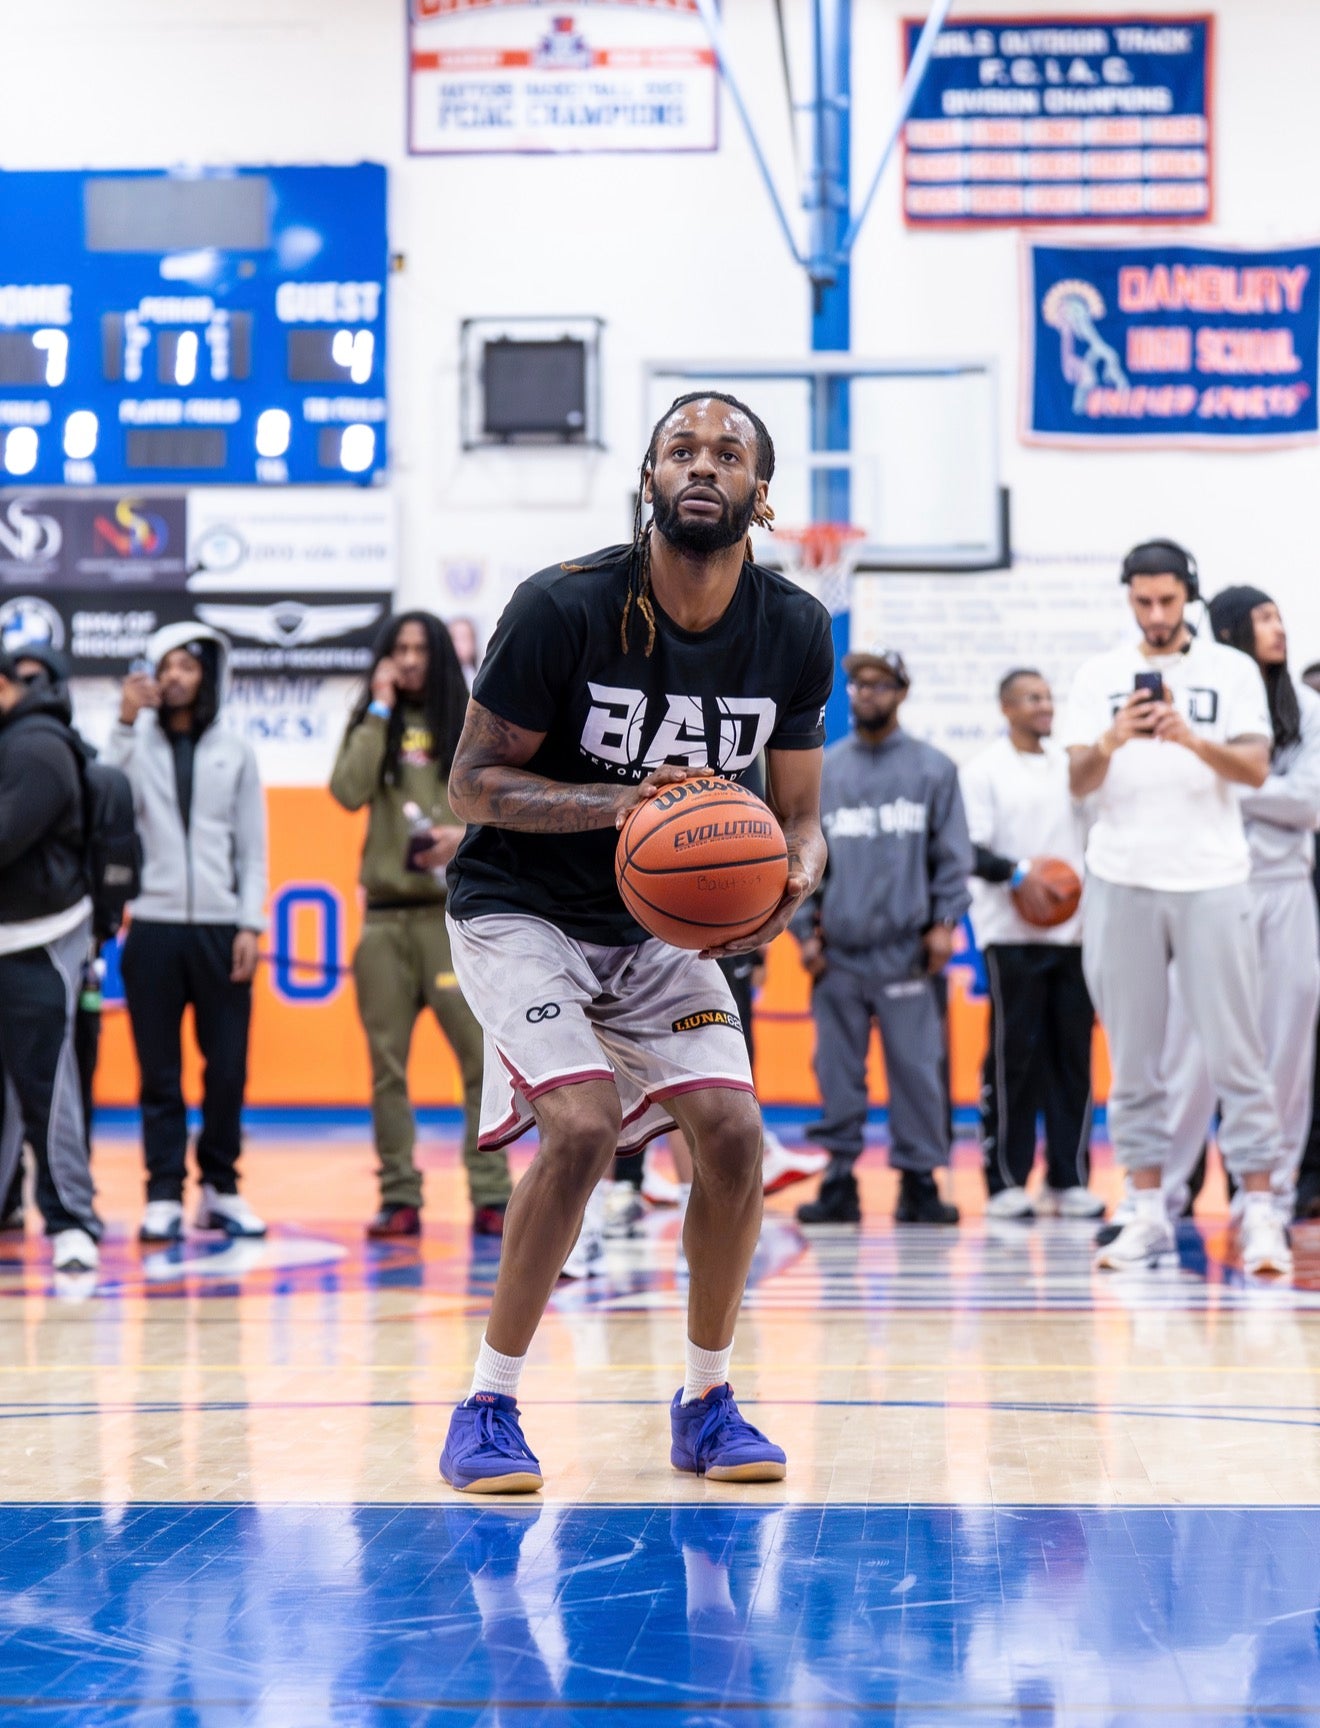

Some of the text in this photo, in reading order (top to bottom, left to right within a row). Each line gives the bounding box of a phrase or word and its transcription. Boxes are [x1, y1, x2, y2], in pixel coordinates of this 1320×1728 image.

[1043, 86, 1173, 113] CHAMPIONS
[276, 281, 381, 323] GUEST
[1118, 264, 1310, 314] DANBURY
[32, 328, 69, 387] 7
[174, 330, 198, 386] 1
[331, 329, 375, 384] 4
[579, 681, 777, 773] BAD
[674, 820, 772, 848] EVOLUTION
